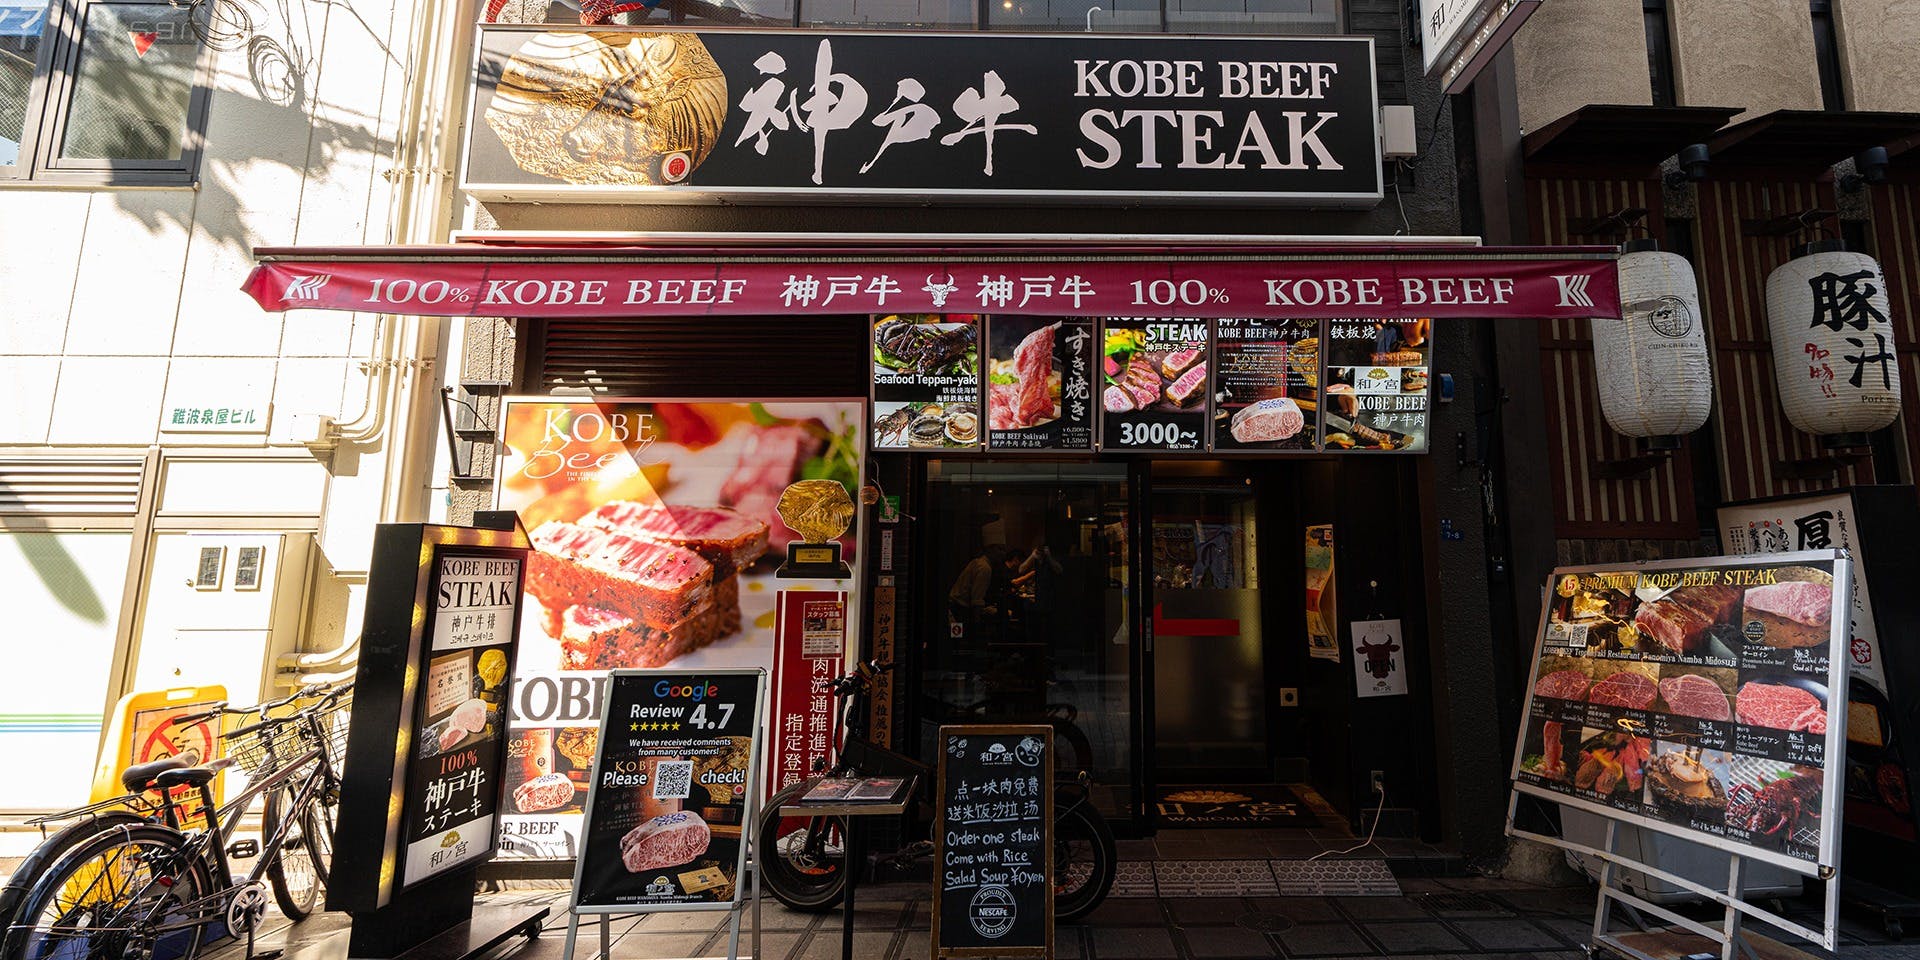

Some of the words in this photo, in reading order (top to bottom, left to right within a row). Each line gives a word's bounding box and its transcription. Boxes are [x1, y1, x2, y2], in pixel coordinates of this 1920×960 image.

[1073, 59, 1205, 97] KOBE
[1218, 61, 1338, 99] BEEF
[735, 38, 1038, 185] 神戸牛
[1076, 108, 1344, 171] STEAK
[363, 278, 470, 305] 100%
[486, 279, 607, 306] KOBE
[622, 278, 747, 305] BEEF
[779, 274, 902, 308] 神戸牛
[975, 275, 1097, 309] 神戸牛
[1130, 278, 1230, 306] 100%
[1264, 278, 1384, 307] KOBE
[1400, 278, 1516, 308] BEEF
[1145, 324, 1206, 341] STEAK
[1218, 328, 1241, 338] KOBE
[1244, 328, 1268, 338] BEEF
[1808, 269, 1895, 391] 豚汁
[1145, 343, 1206, 352] 神戸牛ステーキ
[874, 374, 915, 385] Seafood
[916, 373, 978, 387] Teppan-yaki
[1064, 326, 1091, 422] すき焼き
[1358, 396, 1391, 410] KOBE
[1395, 396, 1427, 411] BEEF
[171, 408, 257, 425] 難波泉屋ビル
[540, 408, 654, 443] KOBE
[441, 559, 480, 576] KOBE
[485, 560, 518, 577] BEEF
[1583, 573, 1639, 591] PREMIUM
[1641, 572, 1680, 589] KOBE
[1682, 570, 1721, 587] BEEF
[1724, 568, 1778, 586] STEAK
[438, 580, 513, 609] STEAK
[1607, 650, 1640, 661] Restaurant
[1704, 656, 1737, 667] Midosuji
[653, 680, 719, 702] Google
[629, 703, 685, 719] Review
[688, 703, 736, 730] 4.7
[807, 657, 830, 777] 肉流通推進協
[629, 738, 641, 747] We
[641, 739, 659, 747] have
[660, 738, 692, 747] received
[693, 738, 731, 747] comments
[1791, 742, 1805, 753] Very
[638, 747, 656, 756] from
[656, 749, 678, 758] many
[678, 747, 719, 756] customers!
[979, 752, 1014, 762] 和ノ宮
[440, 749, 478, 775] 100%
[602, 771, 648, 786] Please
[700, 768, 746, 784] check!
[423, 766, 486, 813] 神戸牛
[954, 776, 1040, 801] 点一块肉免费
[421, 797, 482, 834] ステーキ
[518, 821, 559, 836] BEEF
[947, 830, 981, 847] Order
[983, 832, 1005, 846] one
[1010, 828, 1041, 843] steak
[945, 851, 974, 866] Come
[976, 851, 999, 864] with
[1003, 849, 1029, 862] Rice
[1786, 845, 1818, 861] Lobster
[945, 869, 976, 886] Salad
[980, 868, 1009, 886] Soup
[979, 889, 1007, 900] PROUDLY
[979, 923, 1007, 934] SERVING
